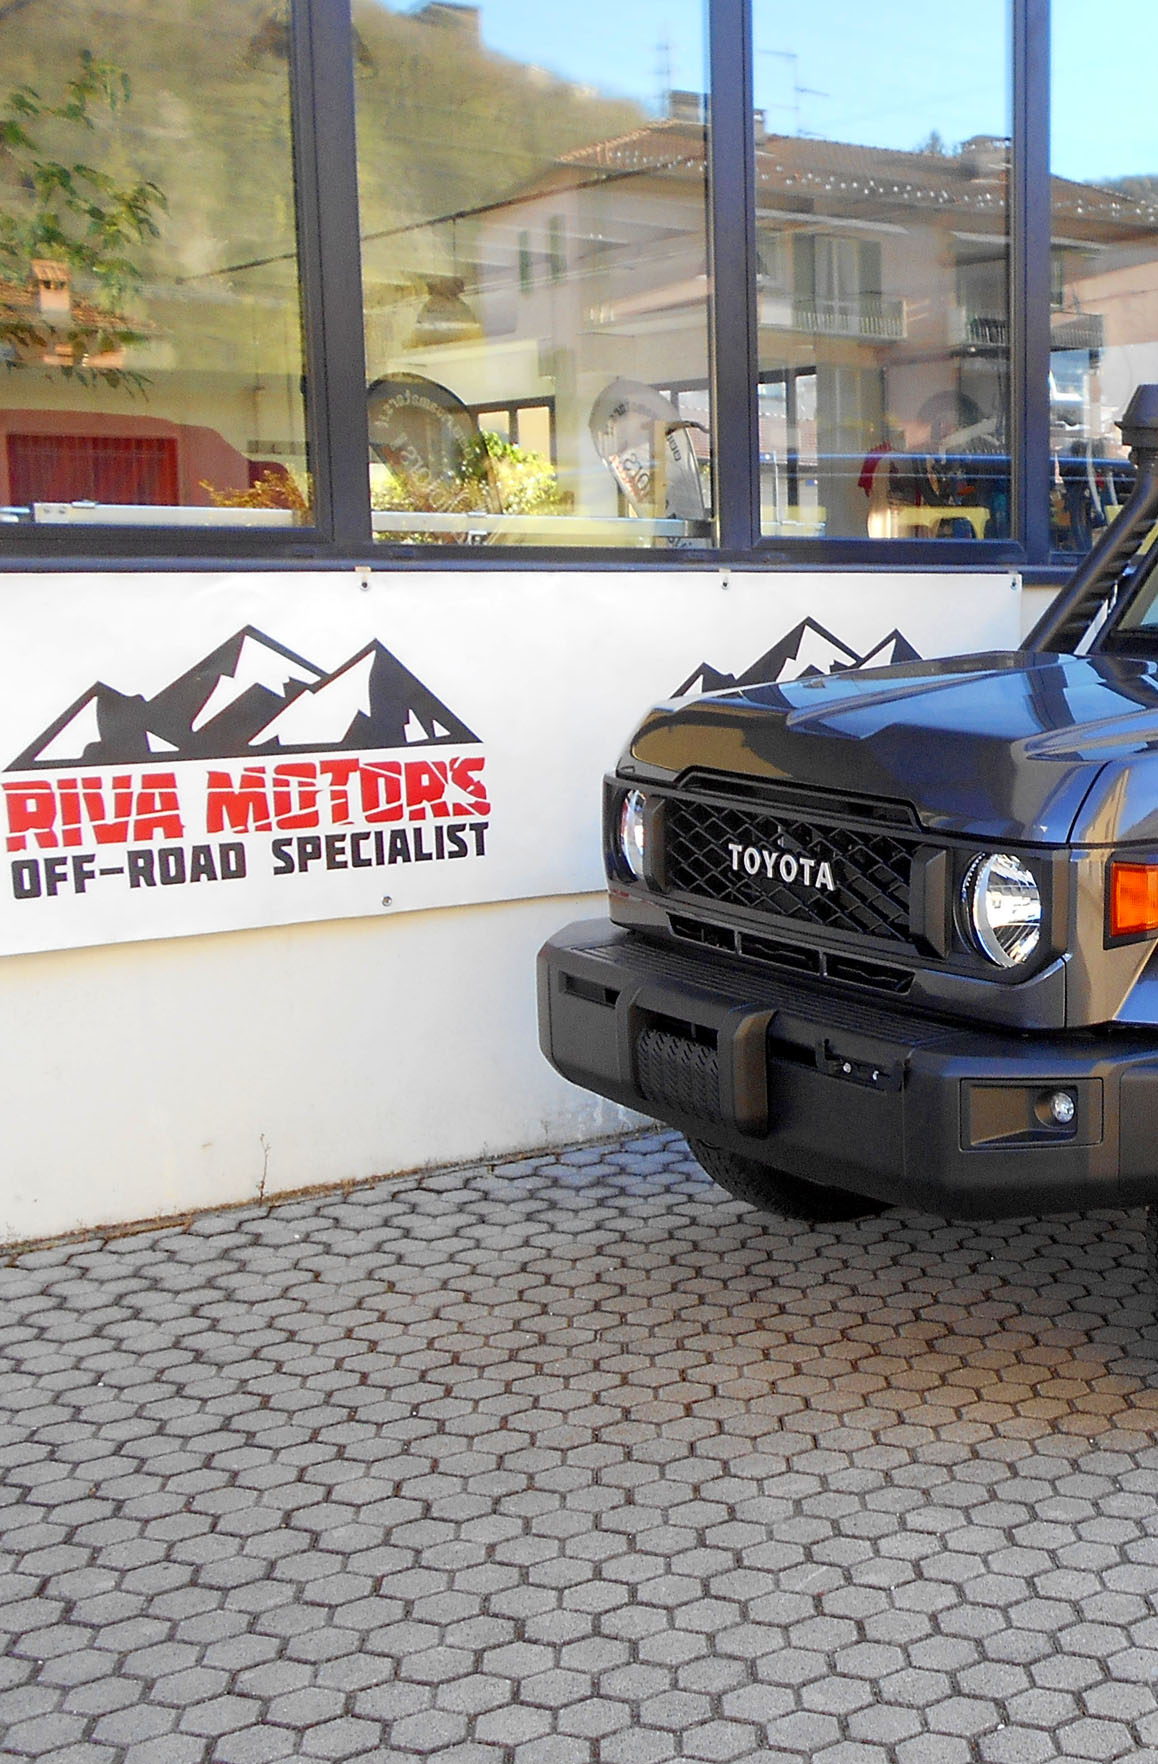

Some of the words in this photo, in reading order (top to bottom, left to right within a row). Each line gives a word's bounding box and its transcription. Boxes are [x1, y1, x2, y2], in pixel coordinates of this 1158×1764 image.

[2, 773, 184, 852] RIVA
[207, 757, 491, 833] MOTORS
[11, 842, 246, 899] OFF-ROAD
[272, 822, 488, 875] SPECIALIST
[728, 843, 836, 892] TOYOTA
